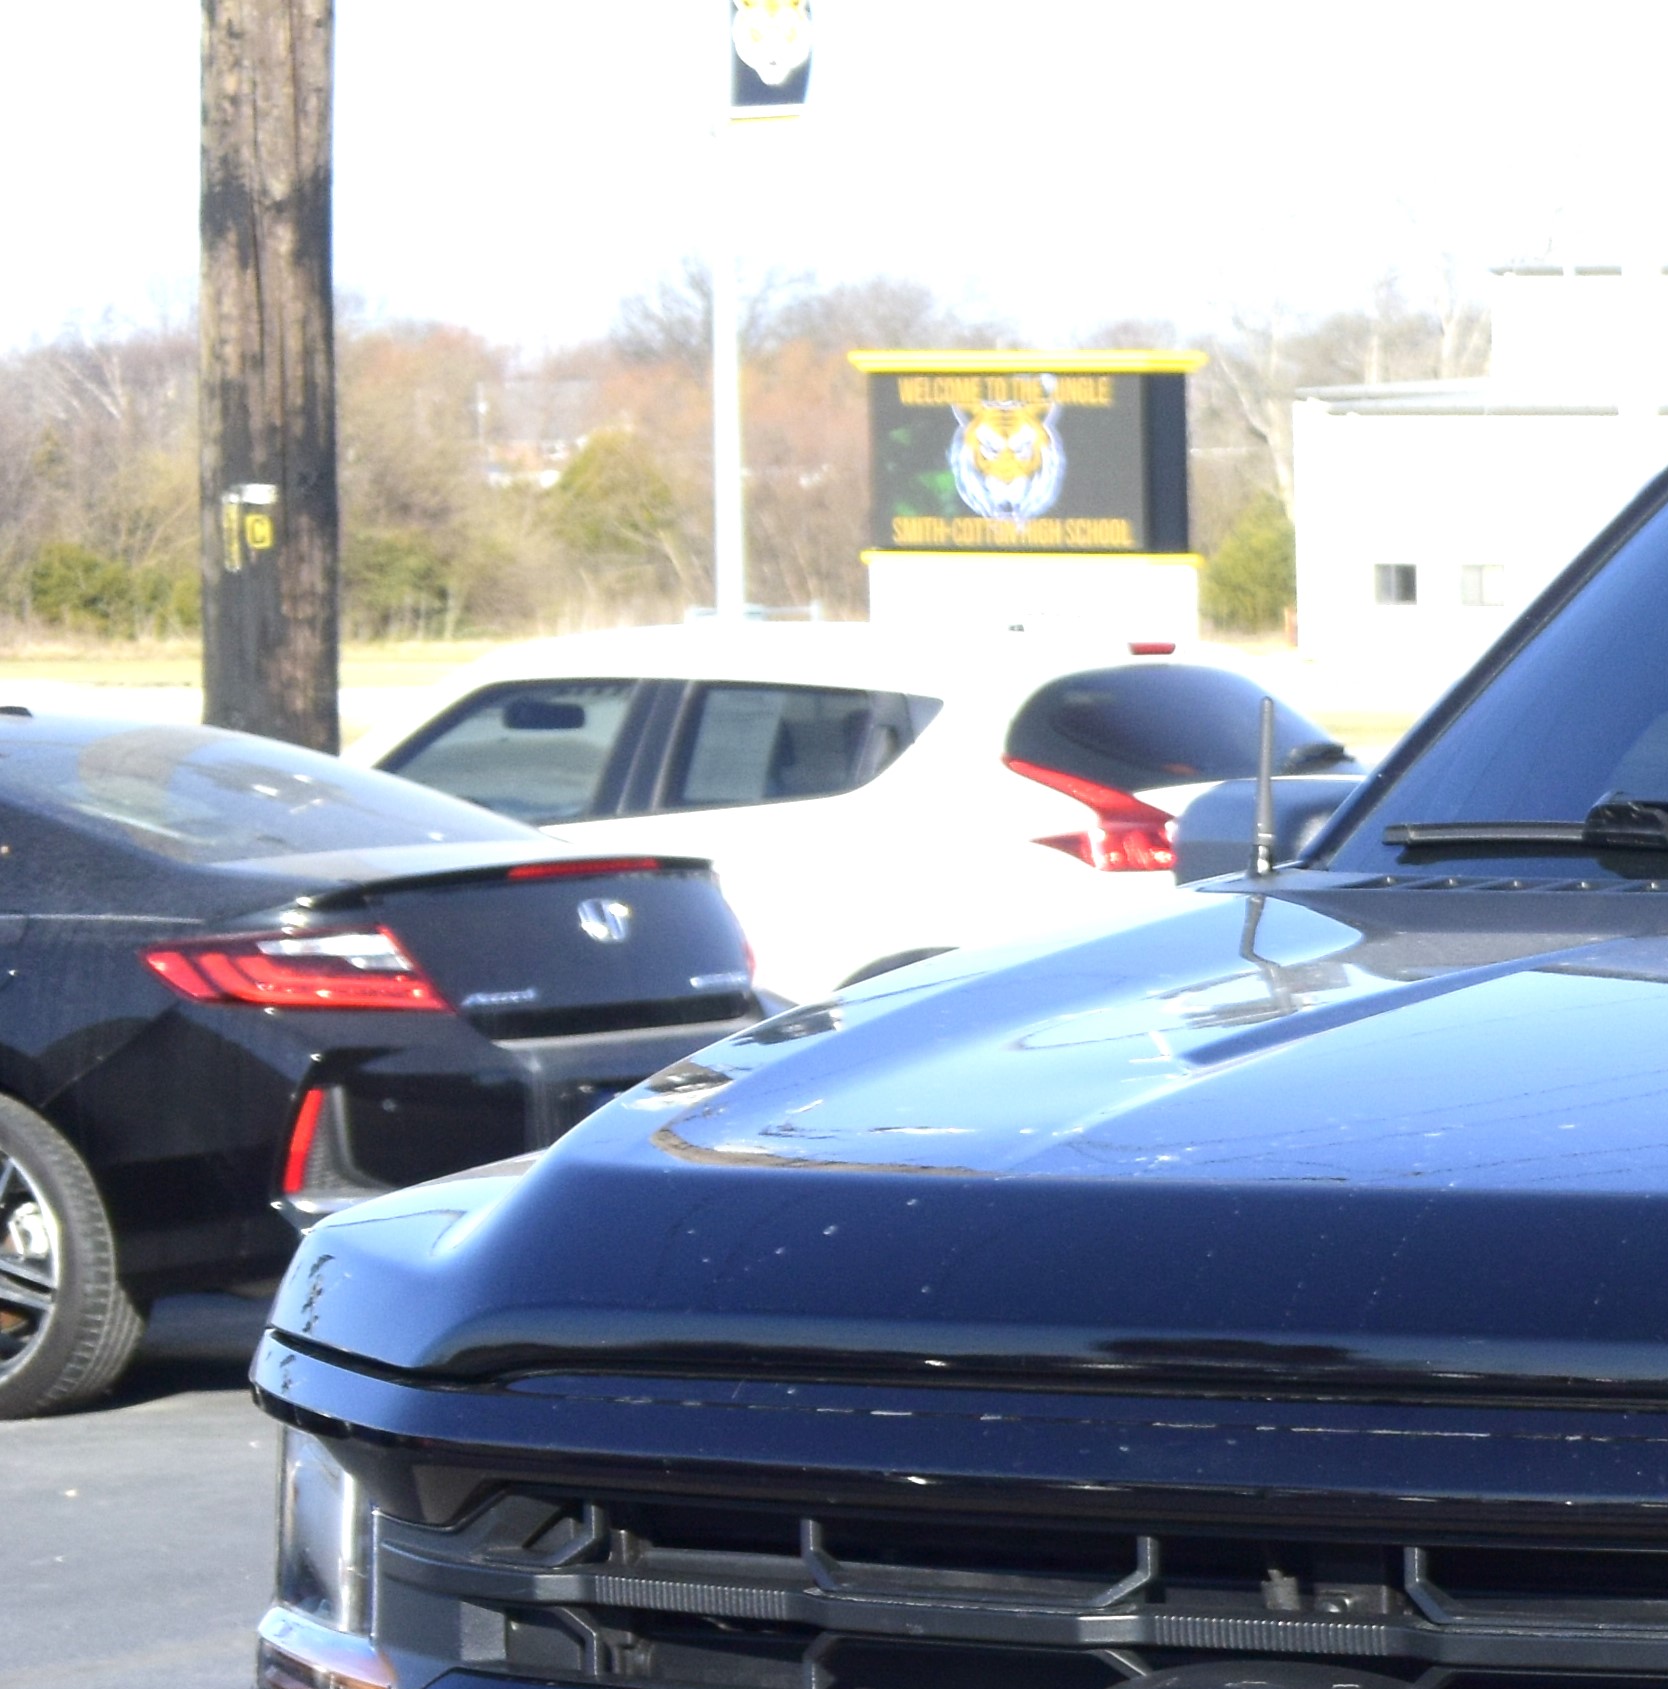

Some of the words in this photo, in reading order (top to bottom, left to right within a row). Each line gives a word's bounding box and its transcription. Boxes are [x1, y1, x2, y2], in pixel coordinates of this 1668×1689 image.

[898, 376, 981, 406] WELCOME
[983, 376, 1008, 402] TO
[1012, 376, 1043, 404] THE
[1023, 518, 1062, 546] HIGH
[1065, 518, 1134, 547] SCHOOL
